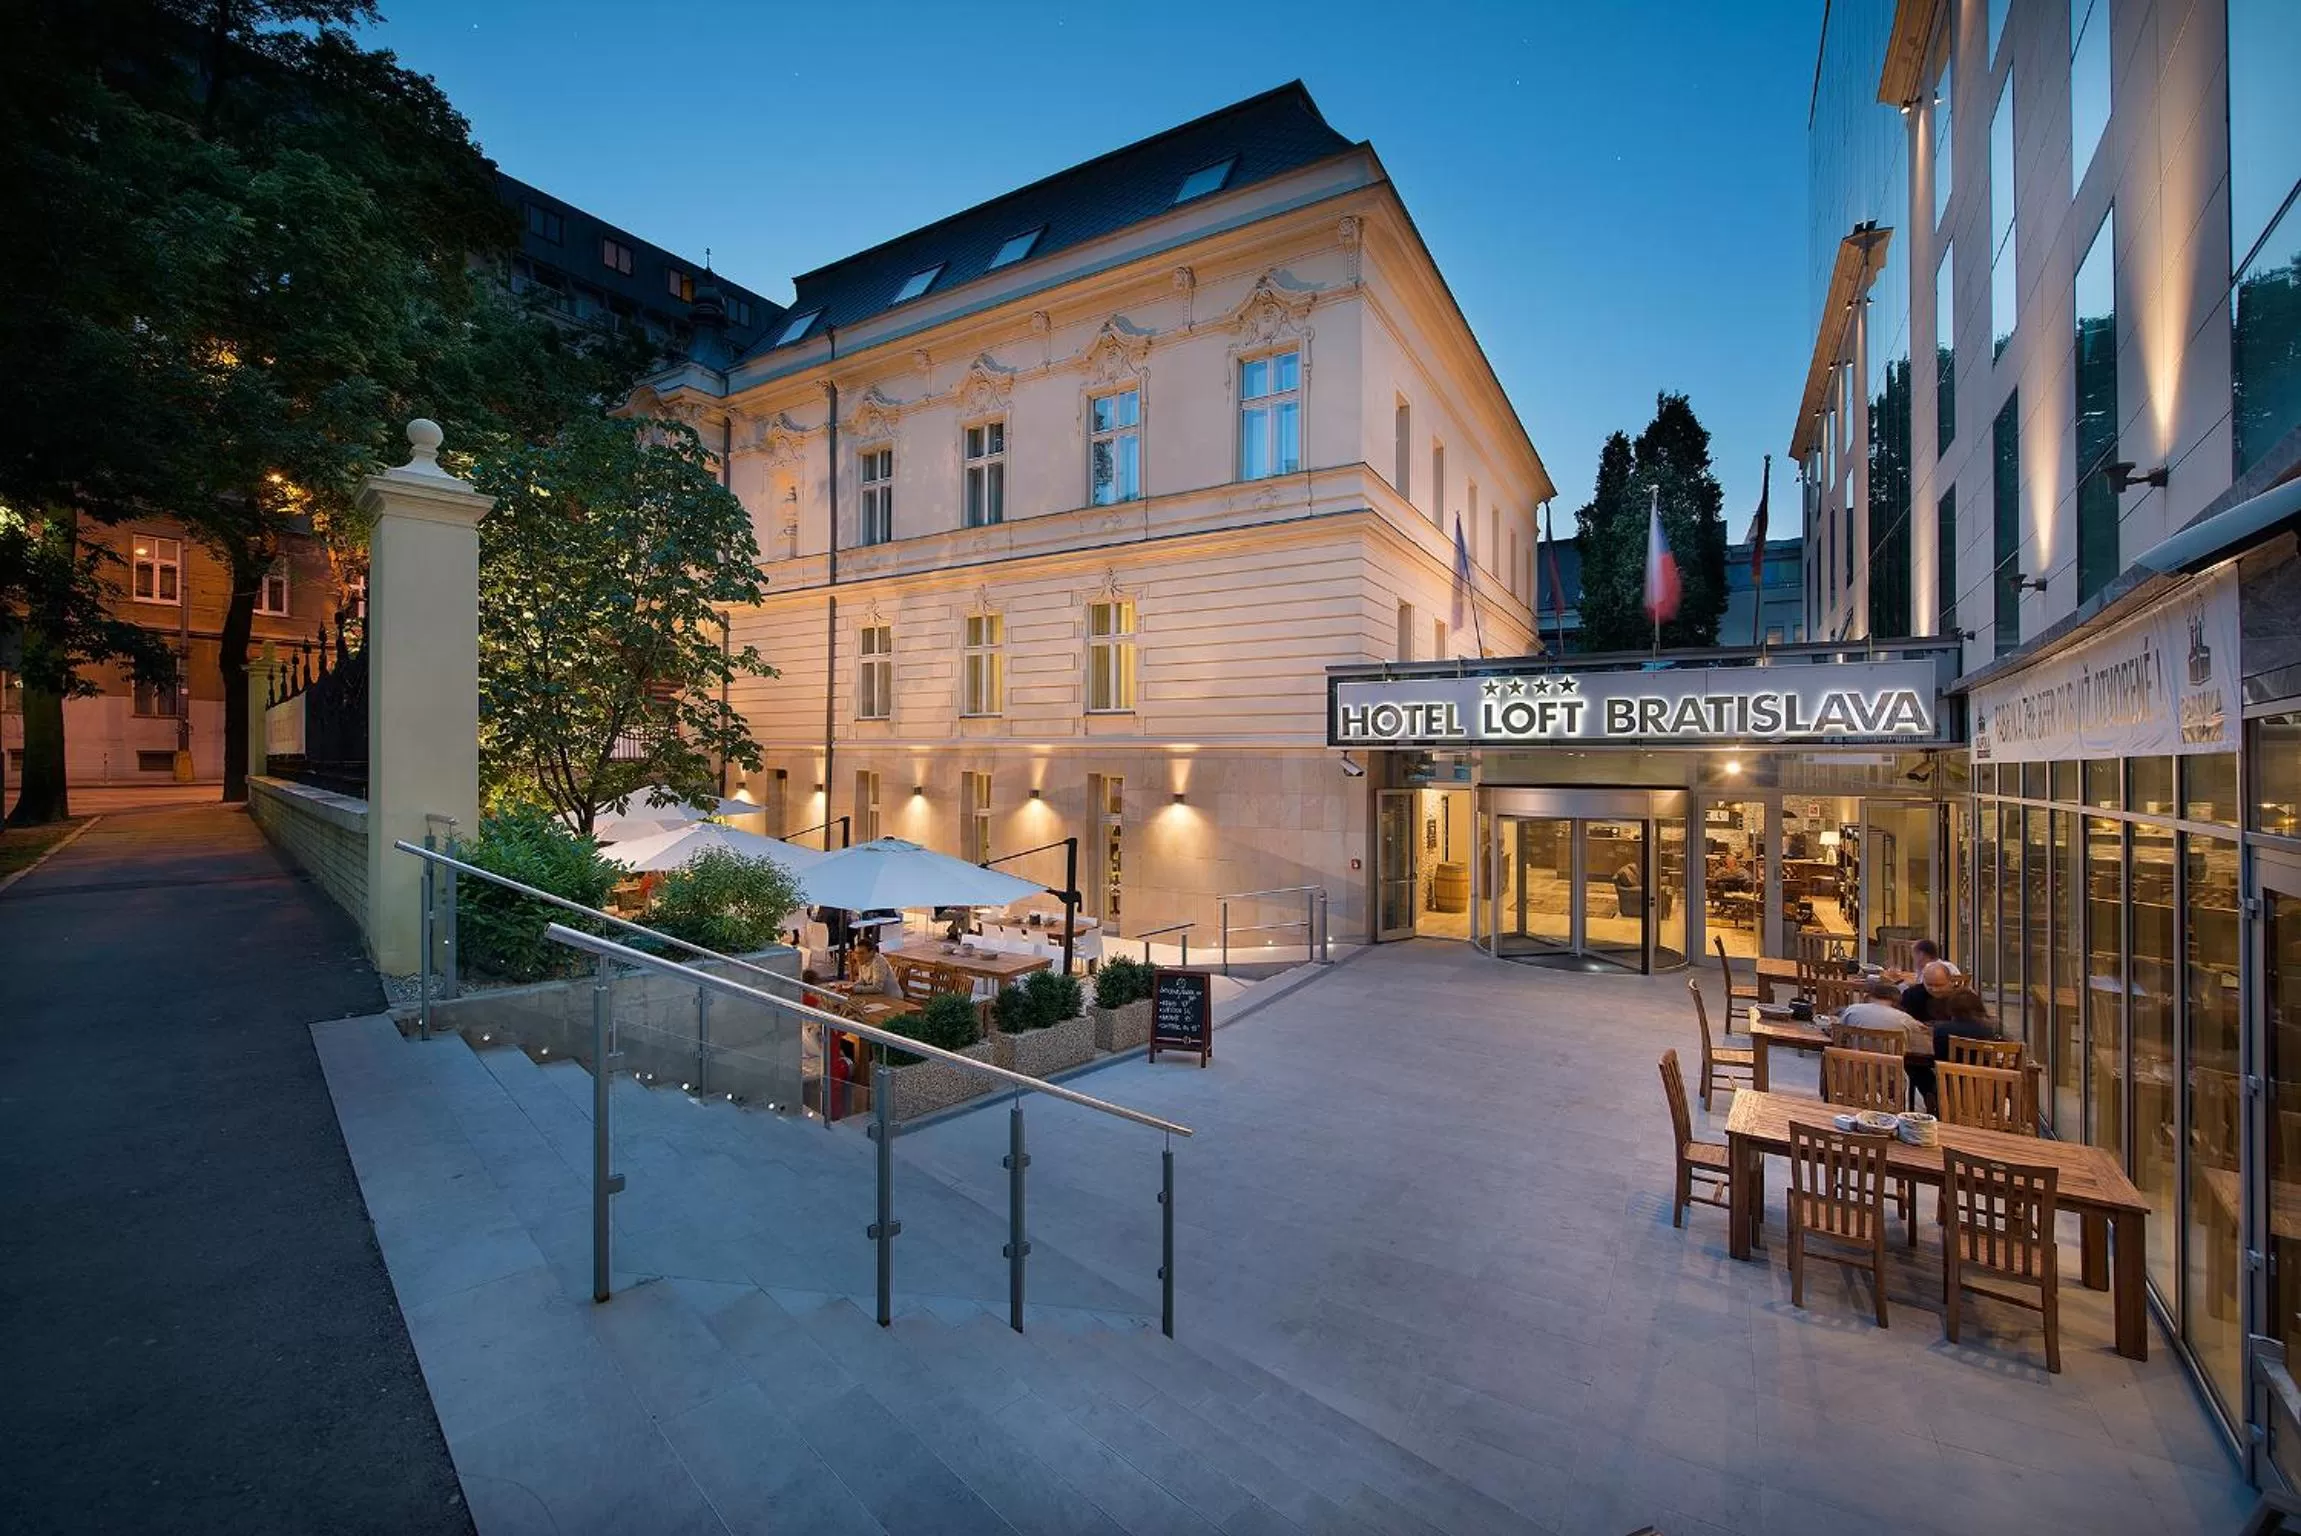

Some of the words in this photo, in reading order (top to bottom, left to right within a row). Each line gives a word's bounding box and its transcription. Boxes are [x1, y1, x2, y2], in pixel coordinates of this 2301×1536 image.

[1341, 703, 1465, 737] HOTEL
[1484, 701, 1584, 734] LOFT
[1606, 691, 1932, 734] BRATISLAVA
